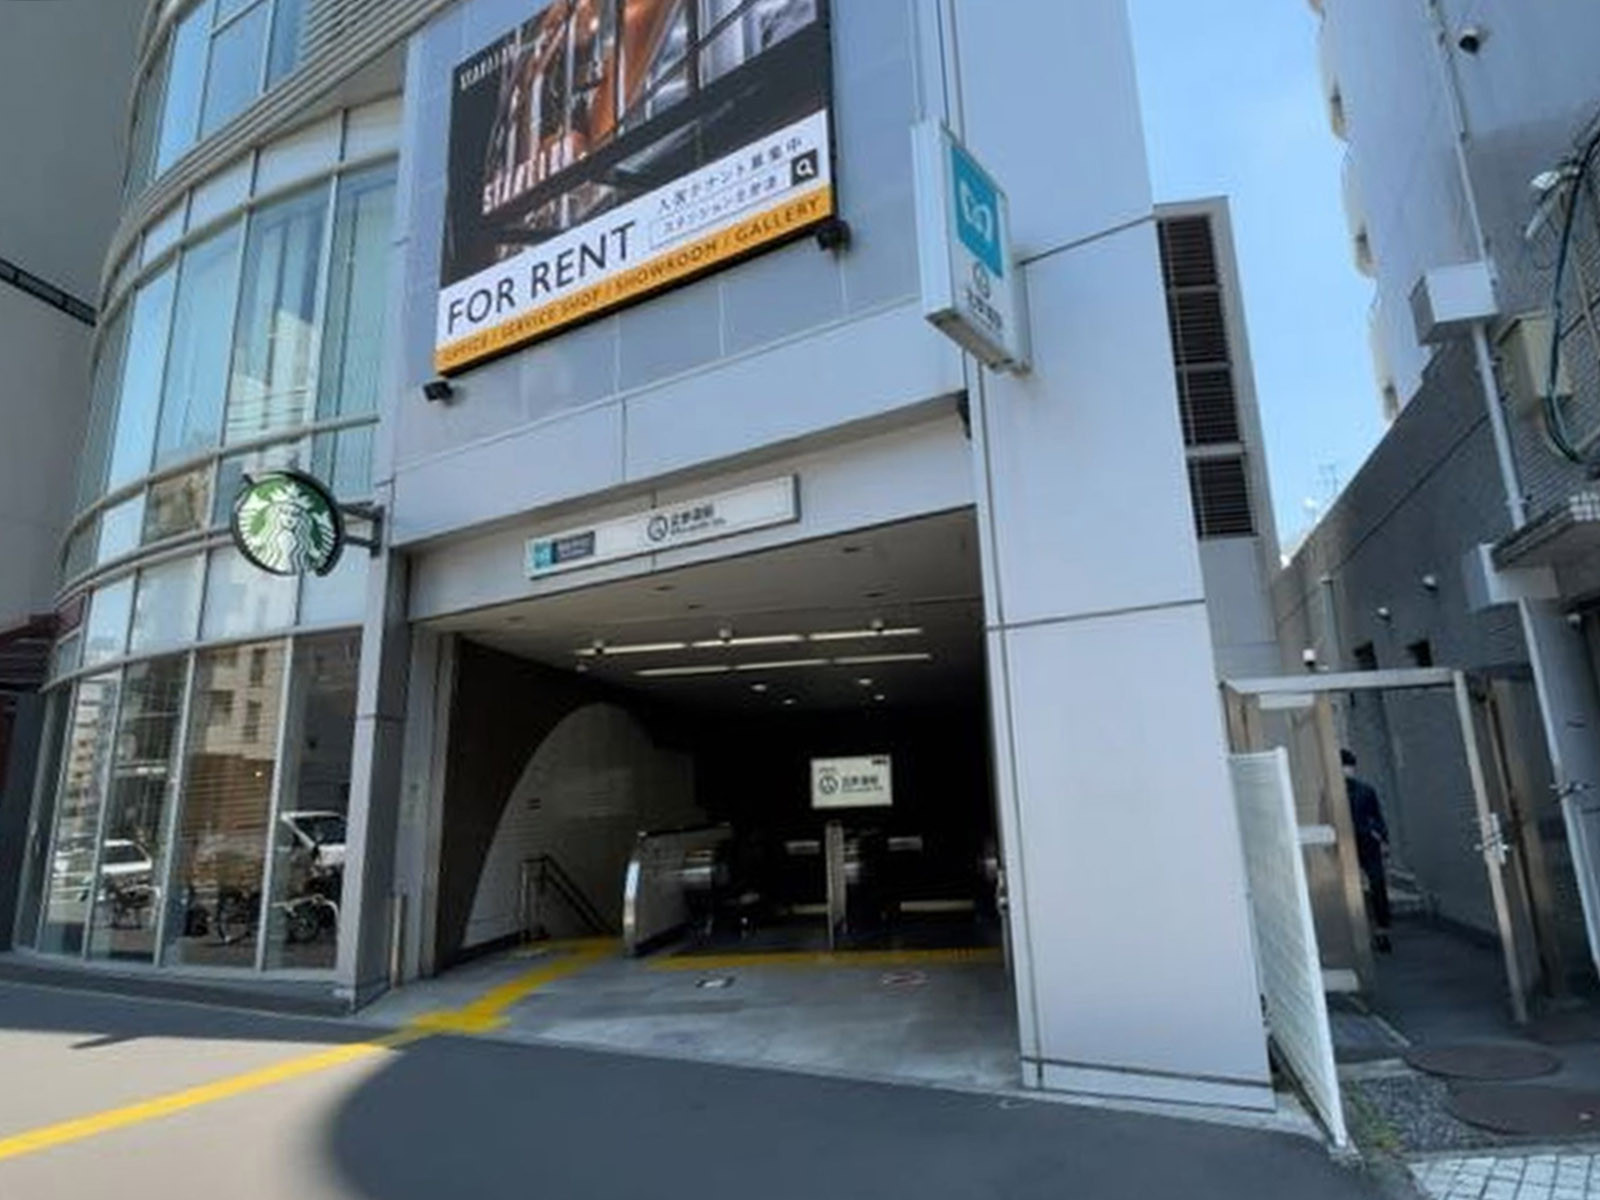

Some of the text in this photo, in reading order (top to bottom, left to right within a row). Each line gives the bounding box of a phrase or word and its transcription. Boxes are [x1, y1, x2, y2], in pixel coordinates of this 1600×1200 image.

[447, 220, 636, 335] FOR RENT
[562, 289, 600, 318] SHOP
[615, 238, 717, 290] SHOWROOM
[734, 194, 820, 242] GALLERY
